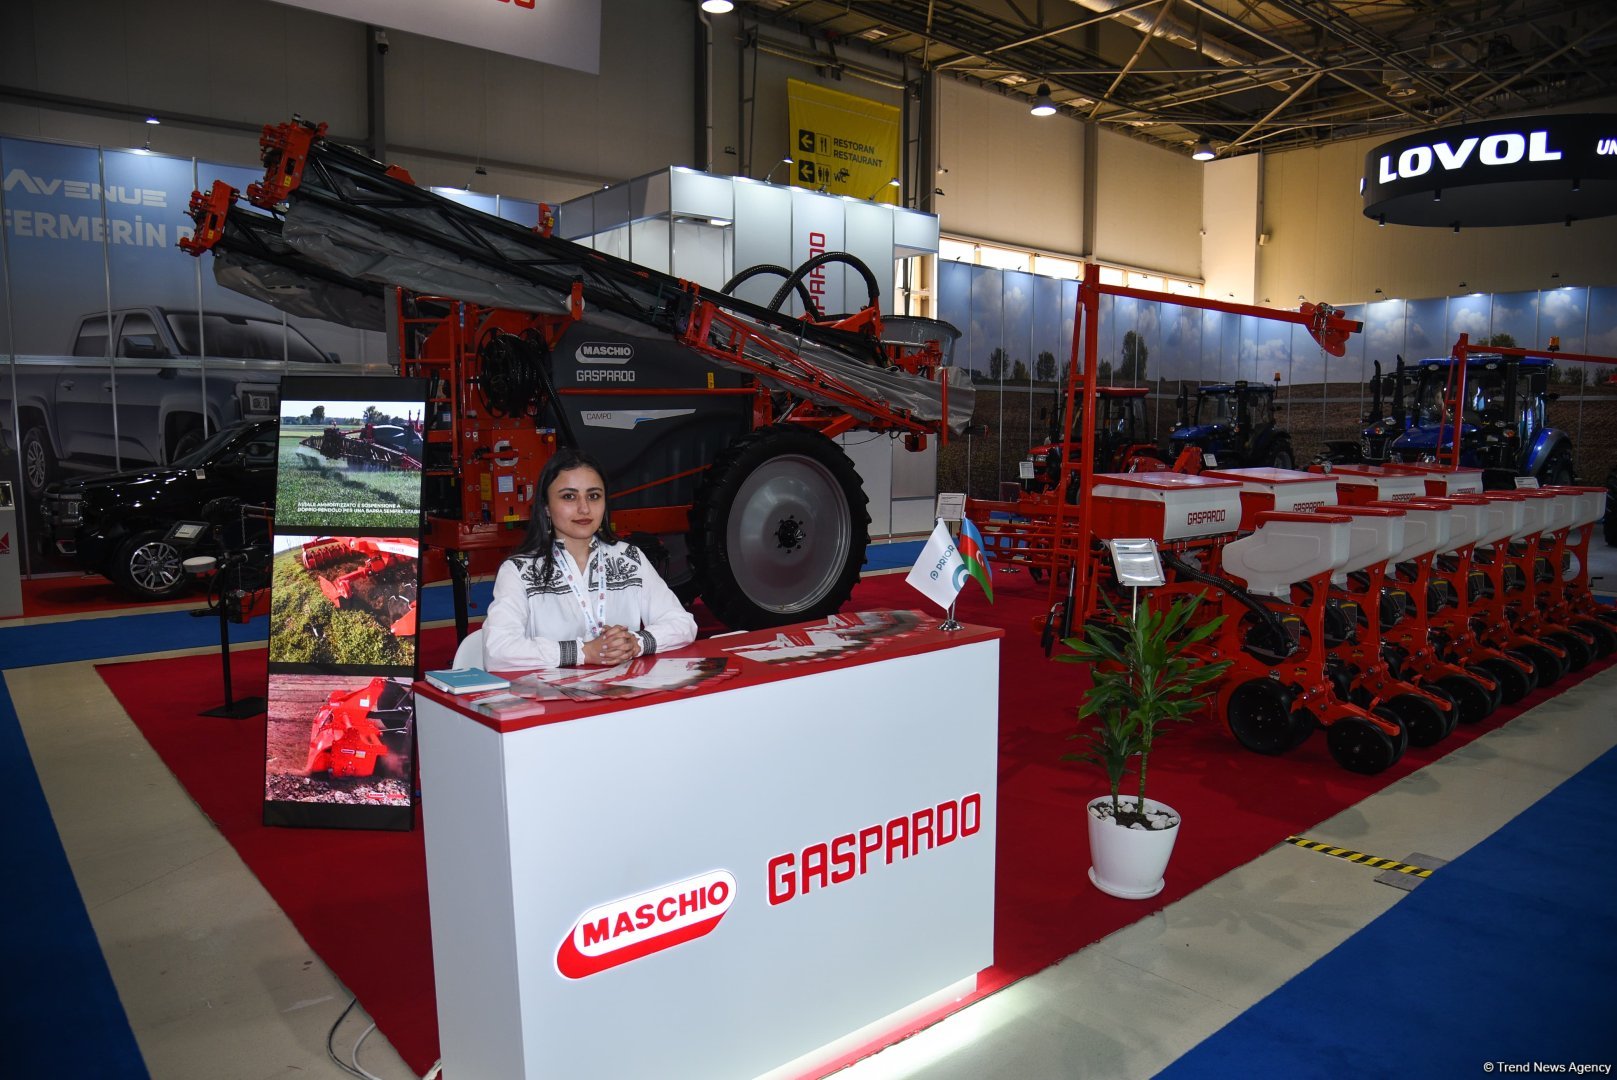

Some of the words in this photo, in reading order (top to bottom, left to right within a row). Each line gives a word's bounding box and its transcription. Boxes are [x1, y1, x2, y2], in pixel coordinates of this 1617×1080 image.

[833, 138, 874, 154] RESTORAN
[833, 150, 883, 167] RESTAURANT
[1379, 131, 1562, 185] LOVOL
[4, 168, 168, 208] AVENUE
[583, 346, 631, 356] MASCHIO
[576, 370, 635, 381] GASPARDO
[586, 412, 612, 420] CAMPO
[1187, 509, 1226, 526] GASPARDO
[936, 544, 955, 571] PRIOR
[767, 792, 981, 906] GASPARDO
[583, 881, 729, 948] MASCHIO
